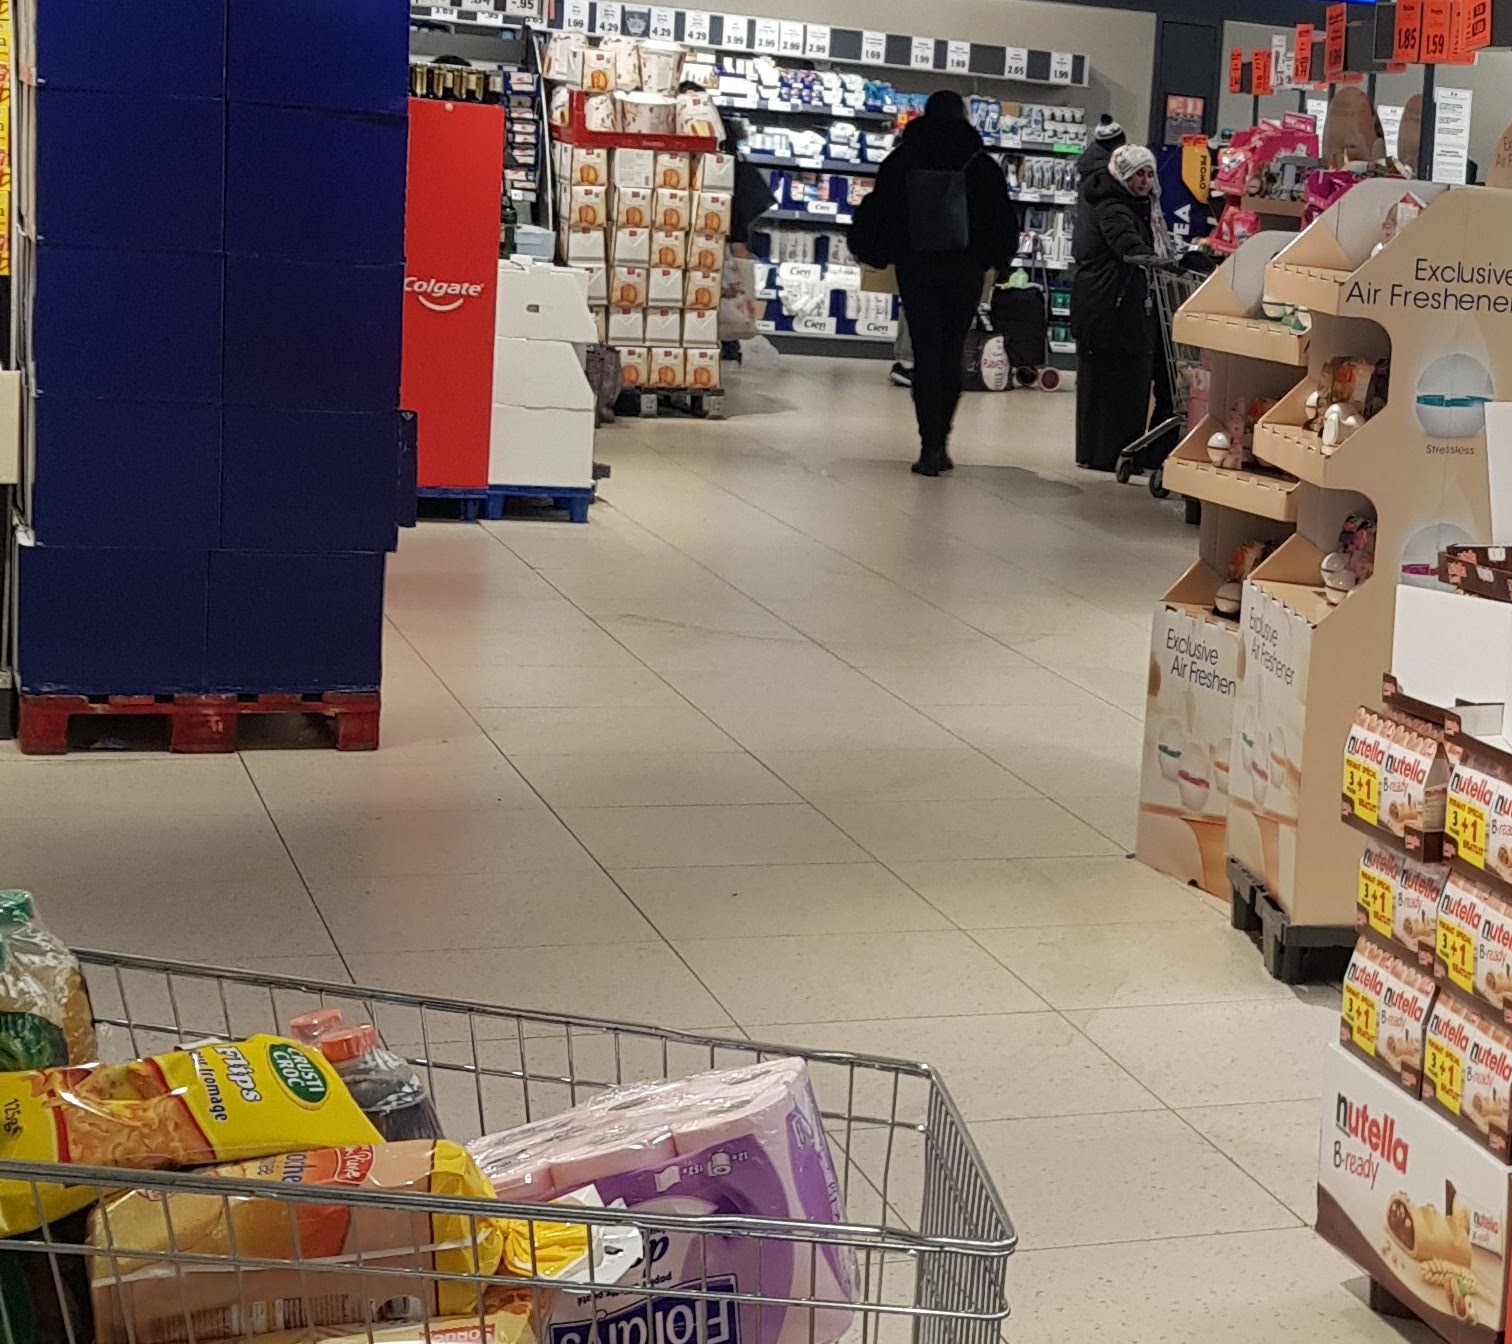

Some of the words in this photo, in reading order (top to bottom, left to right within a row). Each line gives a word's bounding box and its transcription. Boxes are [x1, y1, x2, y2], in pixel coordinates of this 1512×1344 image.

[1426, 34, 1445, 55] 1.59
[1199, 154, 1207, 191] PROMO
[404, 276, 483, 297] Colgate
[1346, 281, 1382, 305] Air
[804, 318, 827, 331] Cien
[866, 321, 889, 334] Cien
[1426, 444, 1475, 456] Stressless
[1166, 627, 1219, 666] Exclusive
[1170, 655, 1187, 679] Air
[1189, 660, 1237, 698] Freshen
[1347, 734, 1385, 766] nutella
[1385, 752, 1427, 786] nutella
[1451, 770, 1494, 807] nutella
[1363, 845, 1398, 881] nutella
[1399, 867, 1441, 904] nutella
[1440, 897, 1482, 933] nutella
[213, 1046, 262, 1103] Flips
[272, 1049, 304, 1087] CROC
[286, 1046, 326, 1093] CRUSTI
[201, 1067, 228, 1122] fromage
[1335, 1091, 1410, 1176] nutella
[1333, 1140, 1380, 1190] B-ready
